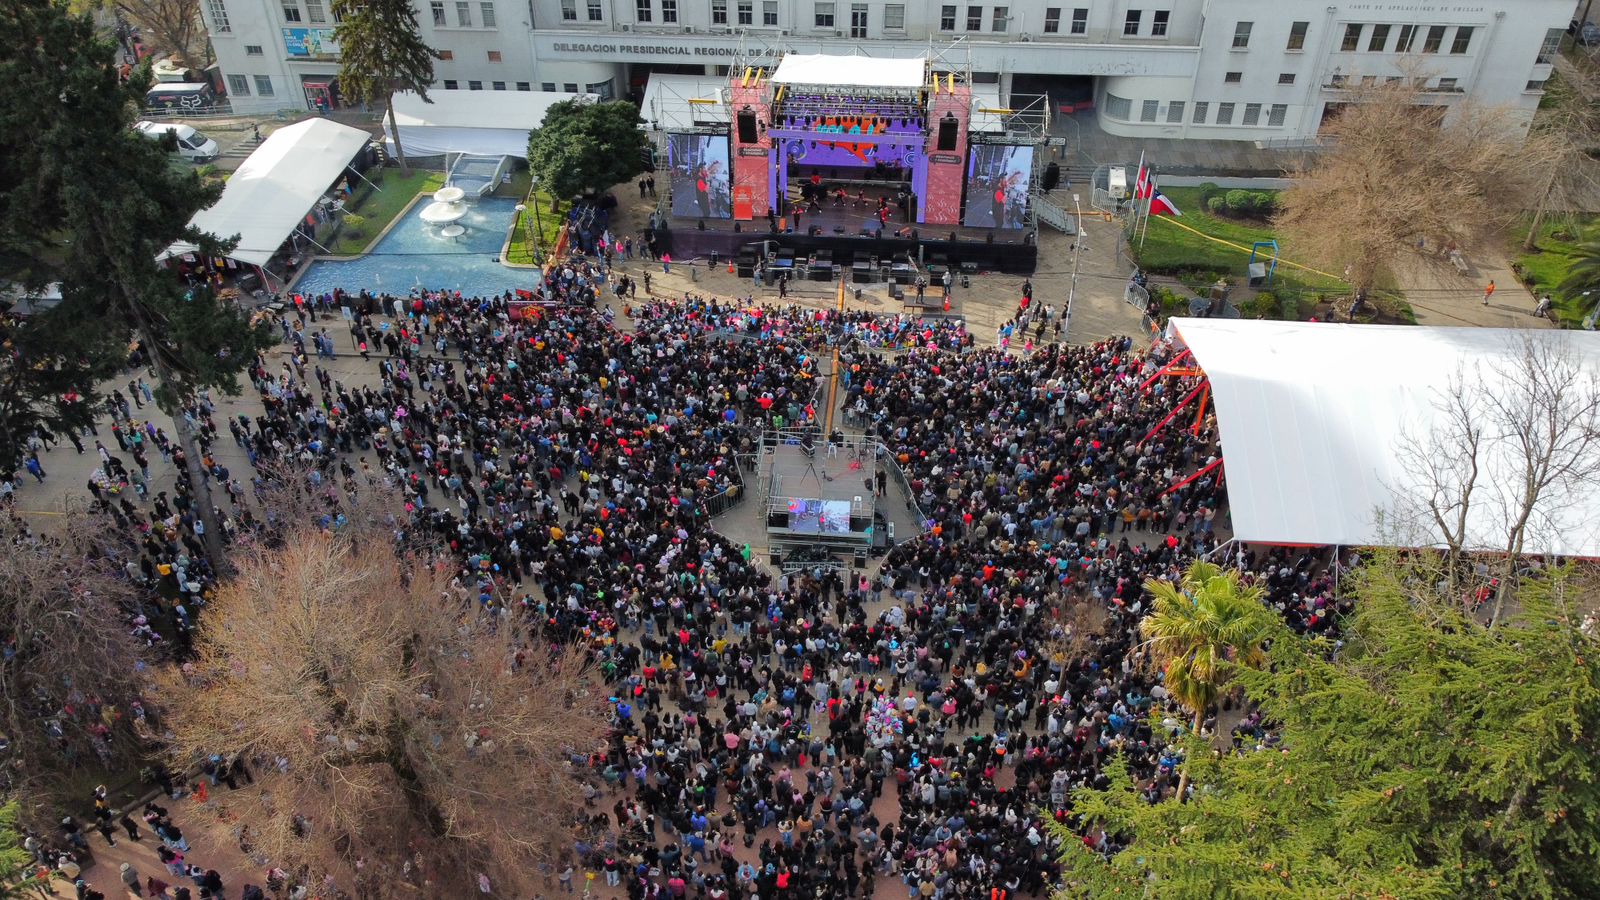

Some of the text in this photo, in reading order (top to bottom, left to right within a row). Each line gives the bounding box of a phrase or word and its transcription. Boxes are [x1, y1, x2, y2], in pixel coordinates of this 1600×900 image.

[553, 43, 616, 53] DELEGACION
[620, 45, 691, 55] PRESIDENCIAL
[694, 47, 746, 57] REGIONA
[748, 49, 762, 57] DE
